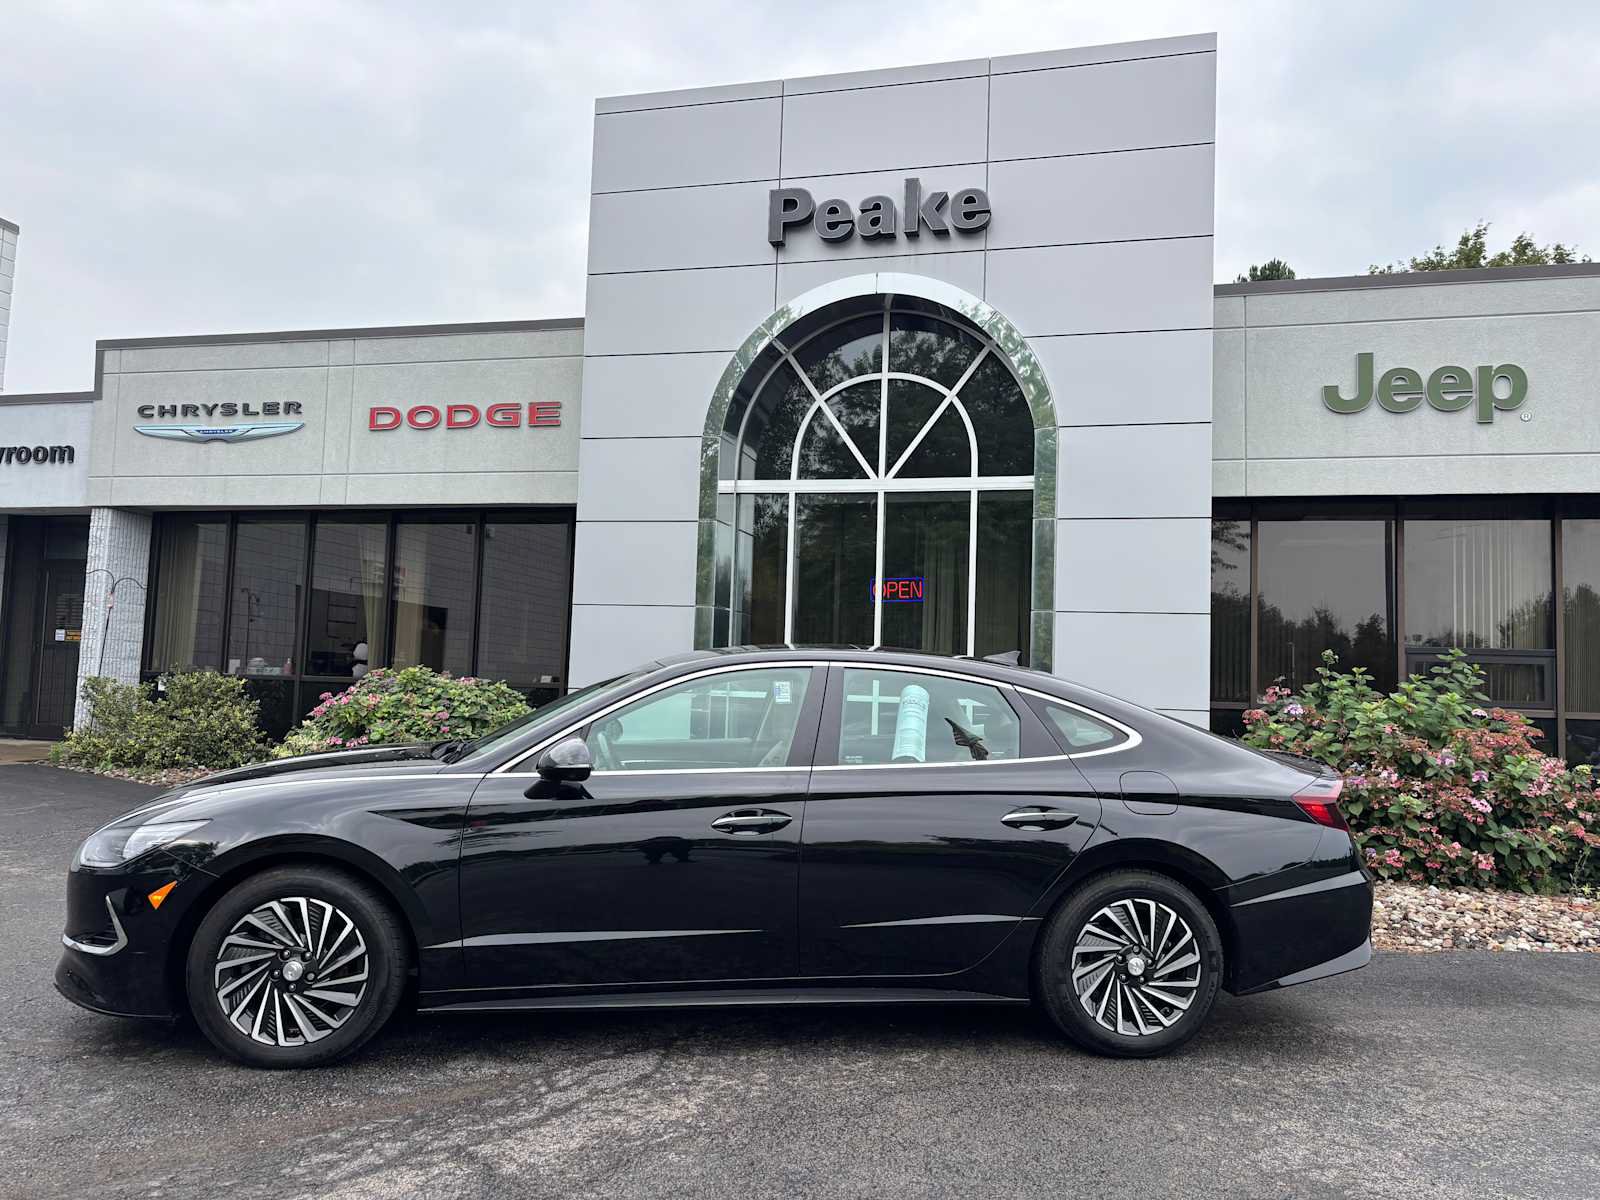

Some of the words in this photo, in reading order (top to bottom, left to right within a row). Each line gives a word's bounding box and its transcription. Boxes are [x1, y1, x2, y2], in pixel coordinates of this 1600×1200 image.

[768, 177, 992, 248] Peake
[137, 401, 303, 419] CHRYSLER
[1321, 351, 1529, 424] Jeep
[368, 401, 562, 431] DODGE
